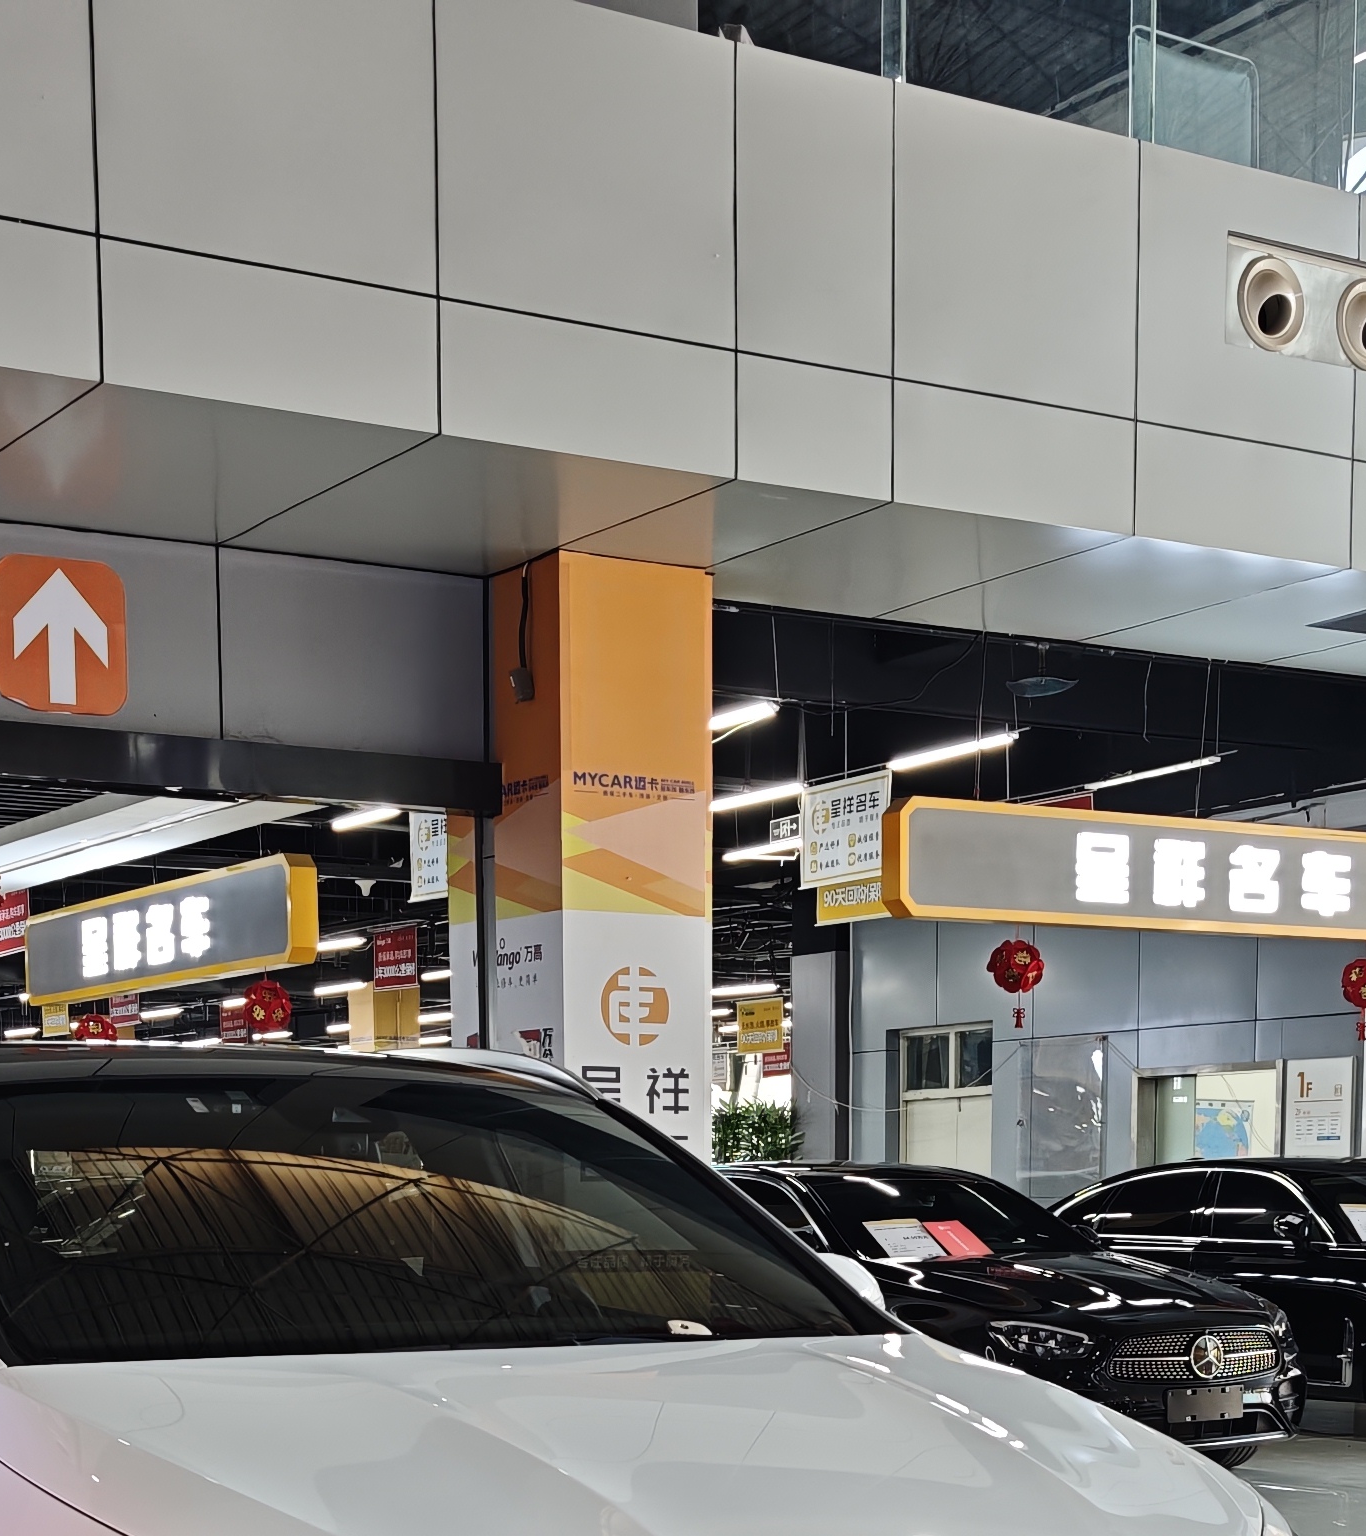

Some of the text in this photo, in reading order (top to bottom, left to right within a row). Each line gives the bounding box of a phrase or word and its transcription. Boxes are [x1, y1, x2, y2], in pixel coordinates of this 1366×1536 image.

[573, 771, 659, 792] MYCAR迈卡
[830, 790, 881, 819] 呈祥名车
[1296, 1071, 1314, 1099] 1F
